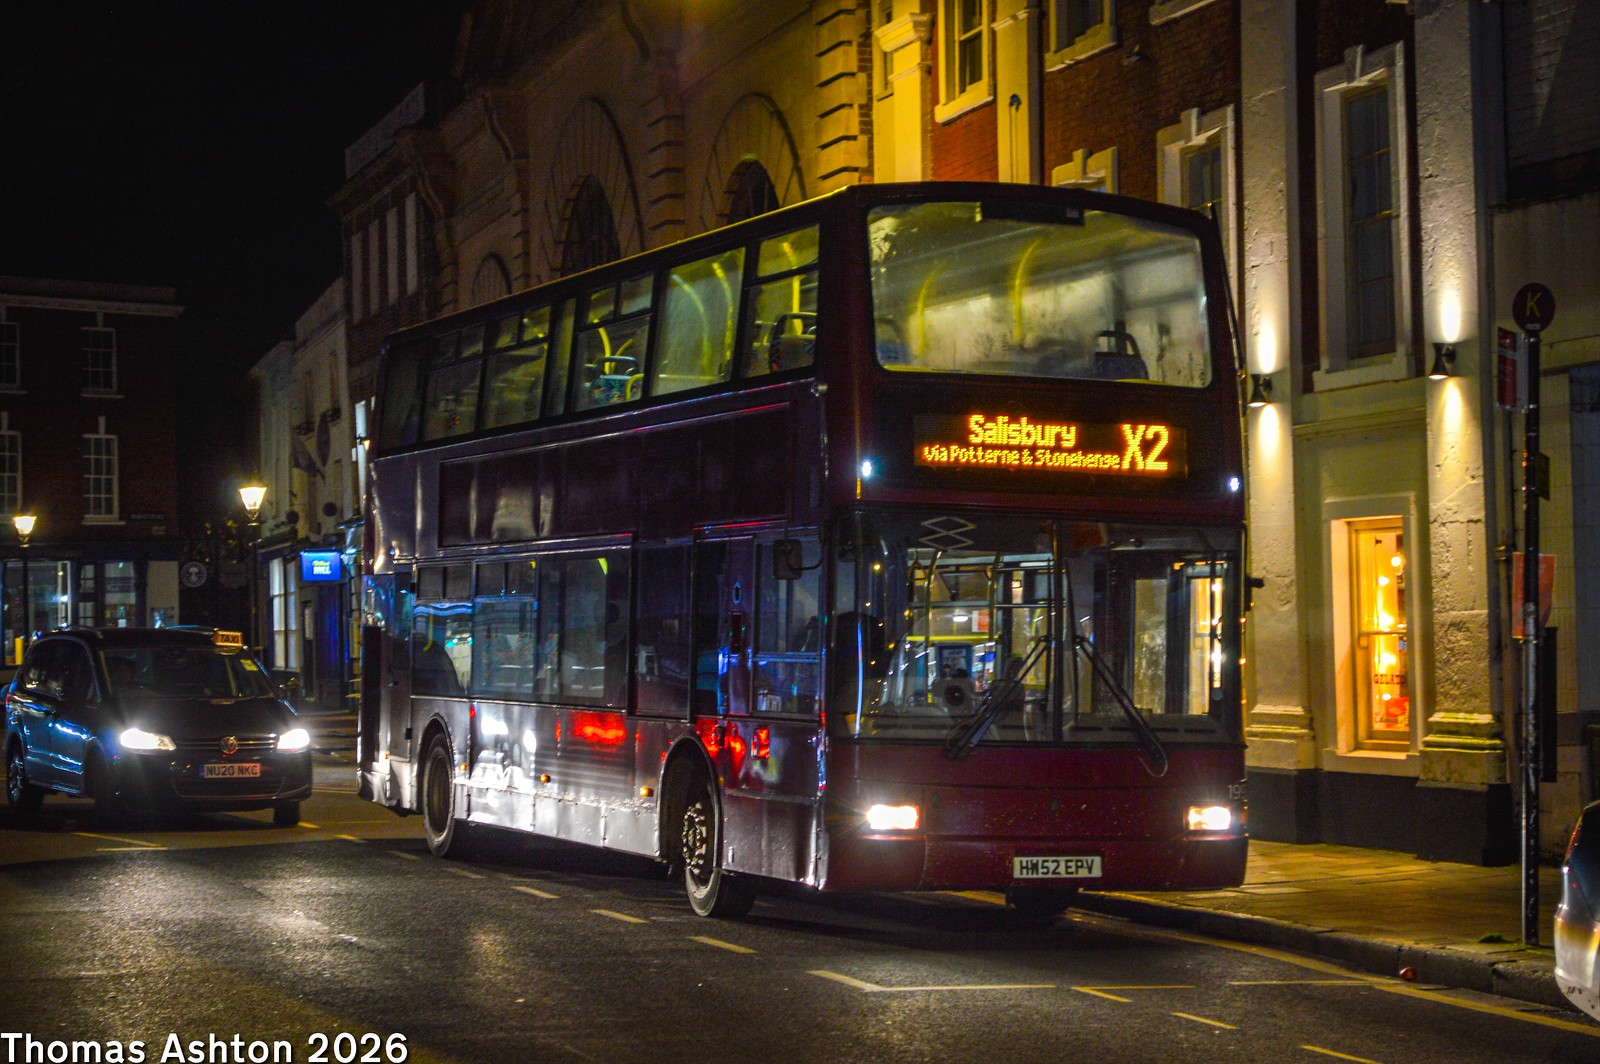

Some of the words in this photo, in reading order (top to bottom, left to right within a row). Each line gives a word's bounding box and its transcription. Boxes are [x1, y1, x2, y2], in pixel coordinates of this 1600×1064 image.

[1526, 291, 1542, 317] K
[968, 414, 1077, 447] Salisbury
[949, 445, 1020, 465] Potterne
[1021, 449, 1033, 465] &
[1034, 449, 1121, 469] Stonehenge
[1121, 423, 1169, 470] X2
[219, 634, 240, 644] TAXI
[206, 765, 235, 776] NU20
[237, 764, 258, 776] NKC
[1019, 859, 1061, 876] HW52
[1064, 859, 1094, 875] EPV
